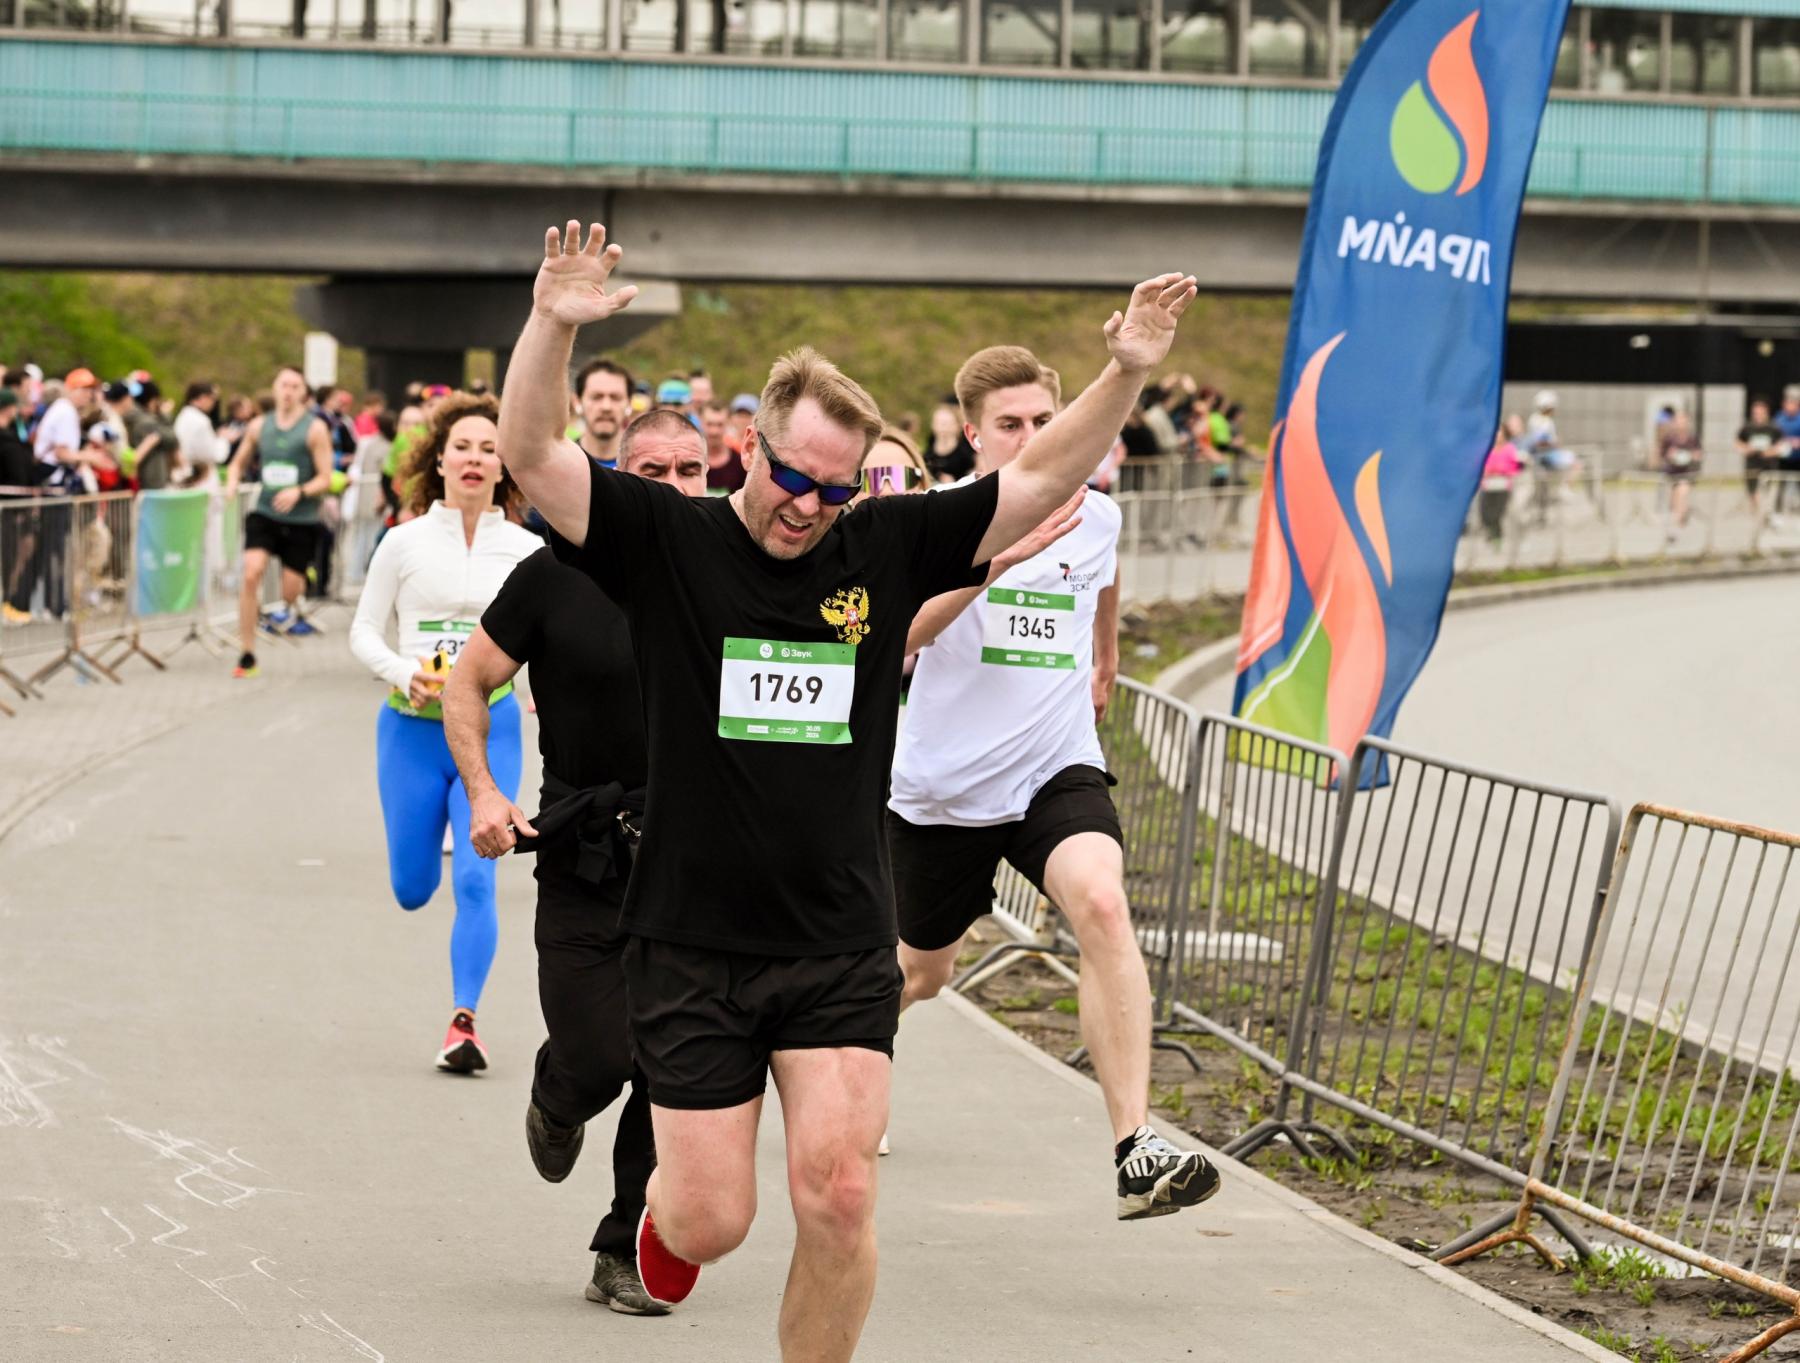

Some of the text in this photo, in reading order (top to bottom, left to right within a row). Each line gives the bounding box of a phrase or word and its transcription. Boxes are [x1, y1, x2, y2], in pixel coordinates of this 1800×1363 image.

[1009, 615, 1055, 639] 1345
[791, 649, 812, 658] Звук
[750, 672, 823, 704] 1769
